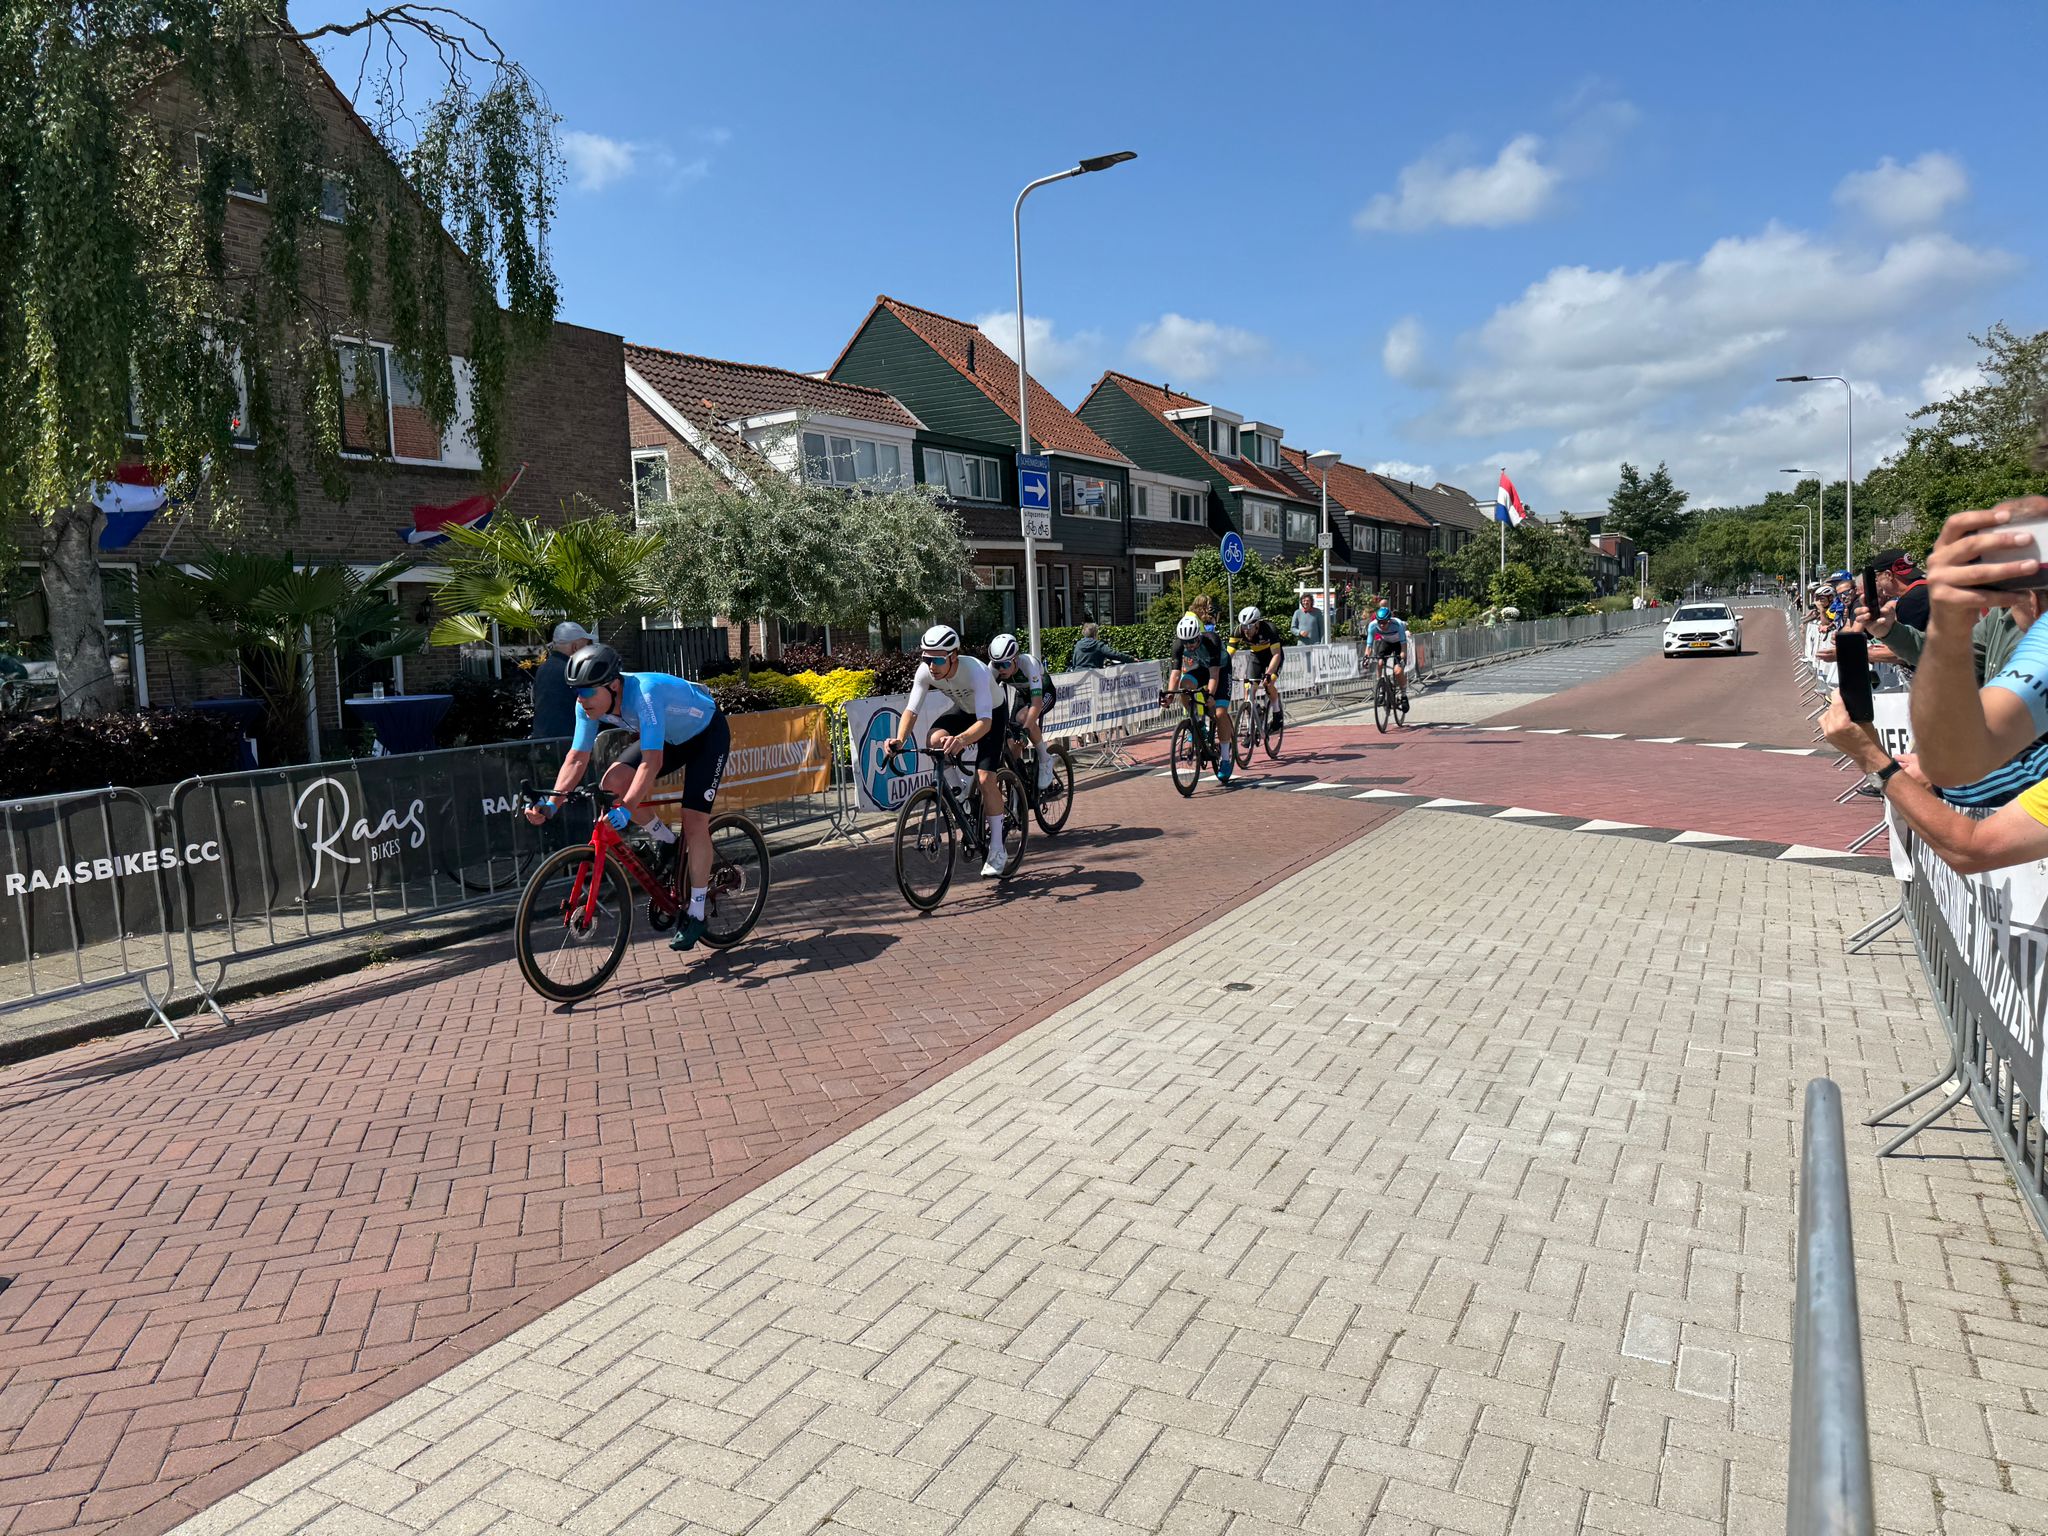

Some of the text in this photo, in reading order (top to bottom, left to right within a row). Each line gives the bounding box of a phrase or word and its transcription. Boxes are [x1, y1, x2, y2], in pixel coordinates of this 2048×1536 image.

[293, 777, 426, 889] Raas
[371, 838, 401, 861] BIKES
[5, 840, 221, 897] RAASBIKES.CC
